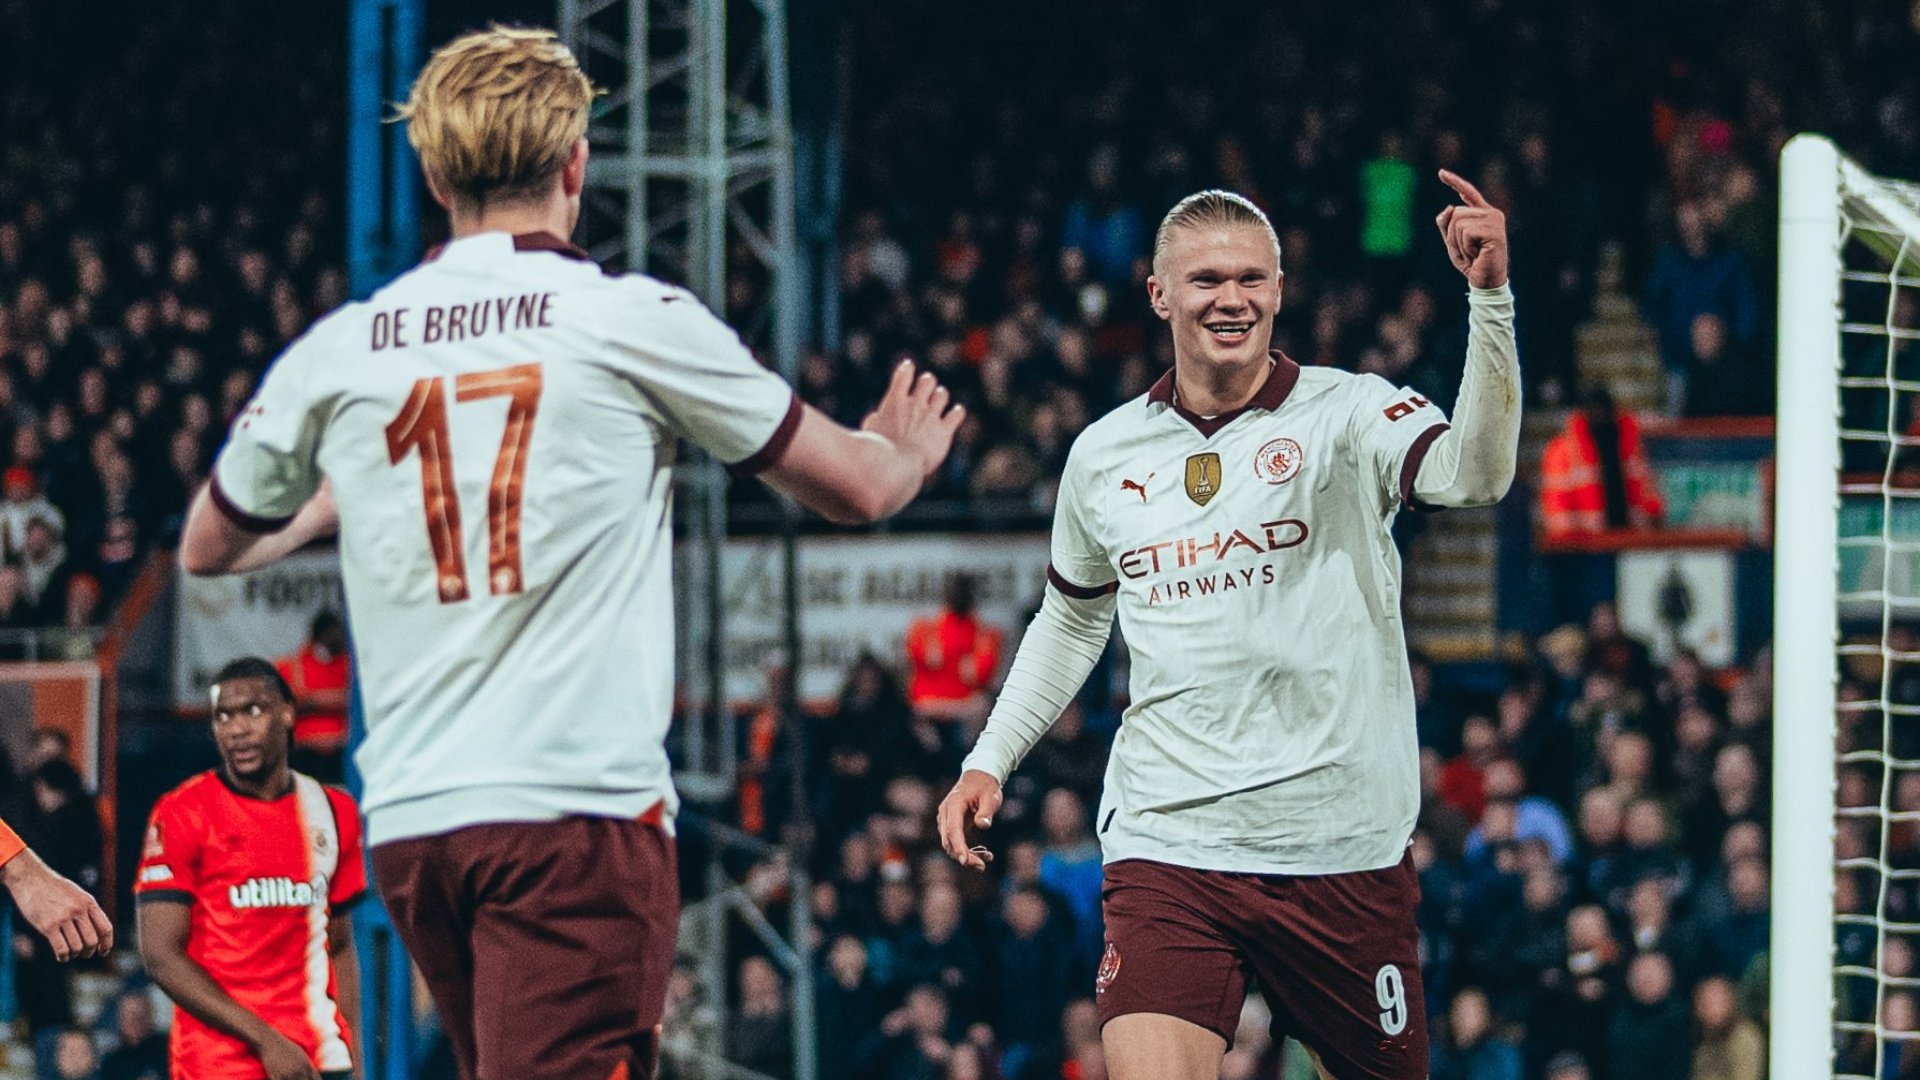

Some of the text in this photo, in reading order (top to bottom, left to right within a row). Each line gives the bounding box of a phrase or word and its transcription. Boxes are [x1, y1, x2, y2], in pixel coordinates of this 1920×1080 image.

[371, 292, 559, 352] DE BRUYNE
[385, 362, 543, 604] 17
[1194, 485, 1211, 495] FIFA
[1119, 518, 1309, 579] ETIHAD
[1149, 564, 1275, 605] AIRWAYS
[229, 876, 313, 909] utilita
[1375, 964, 1408, 1036] 9
